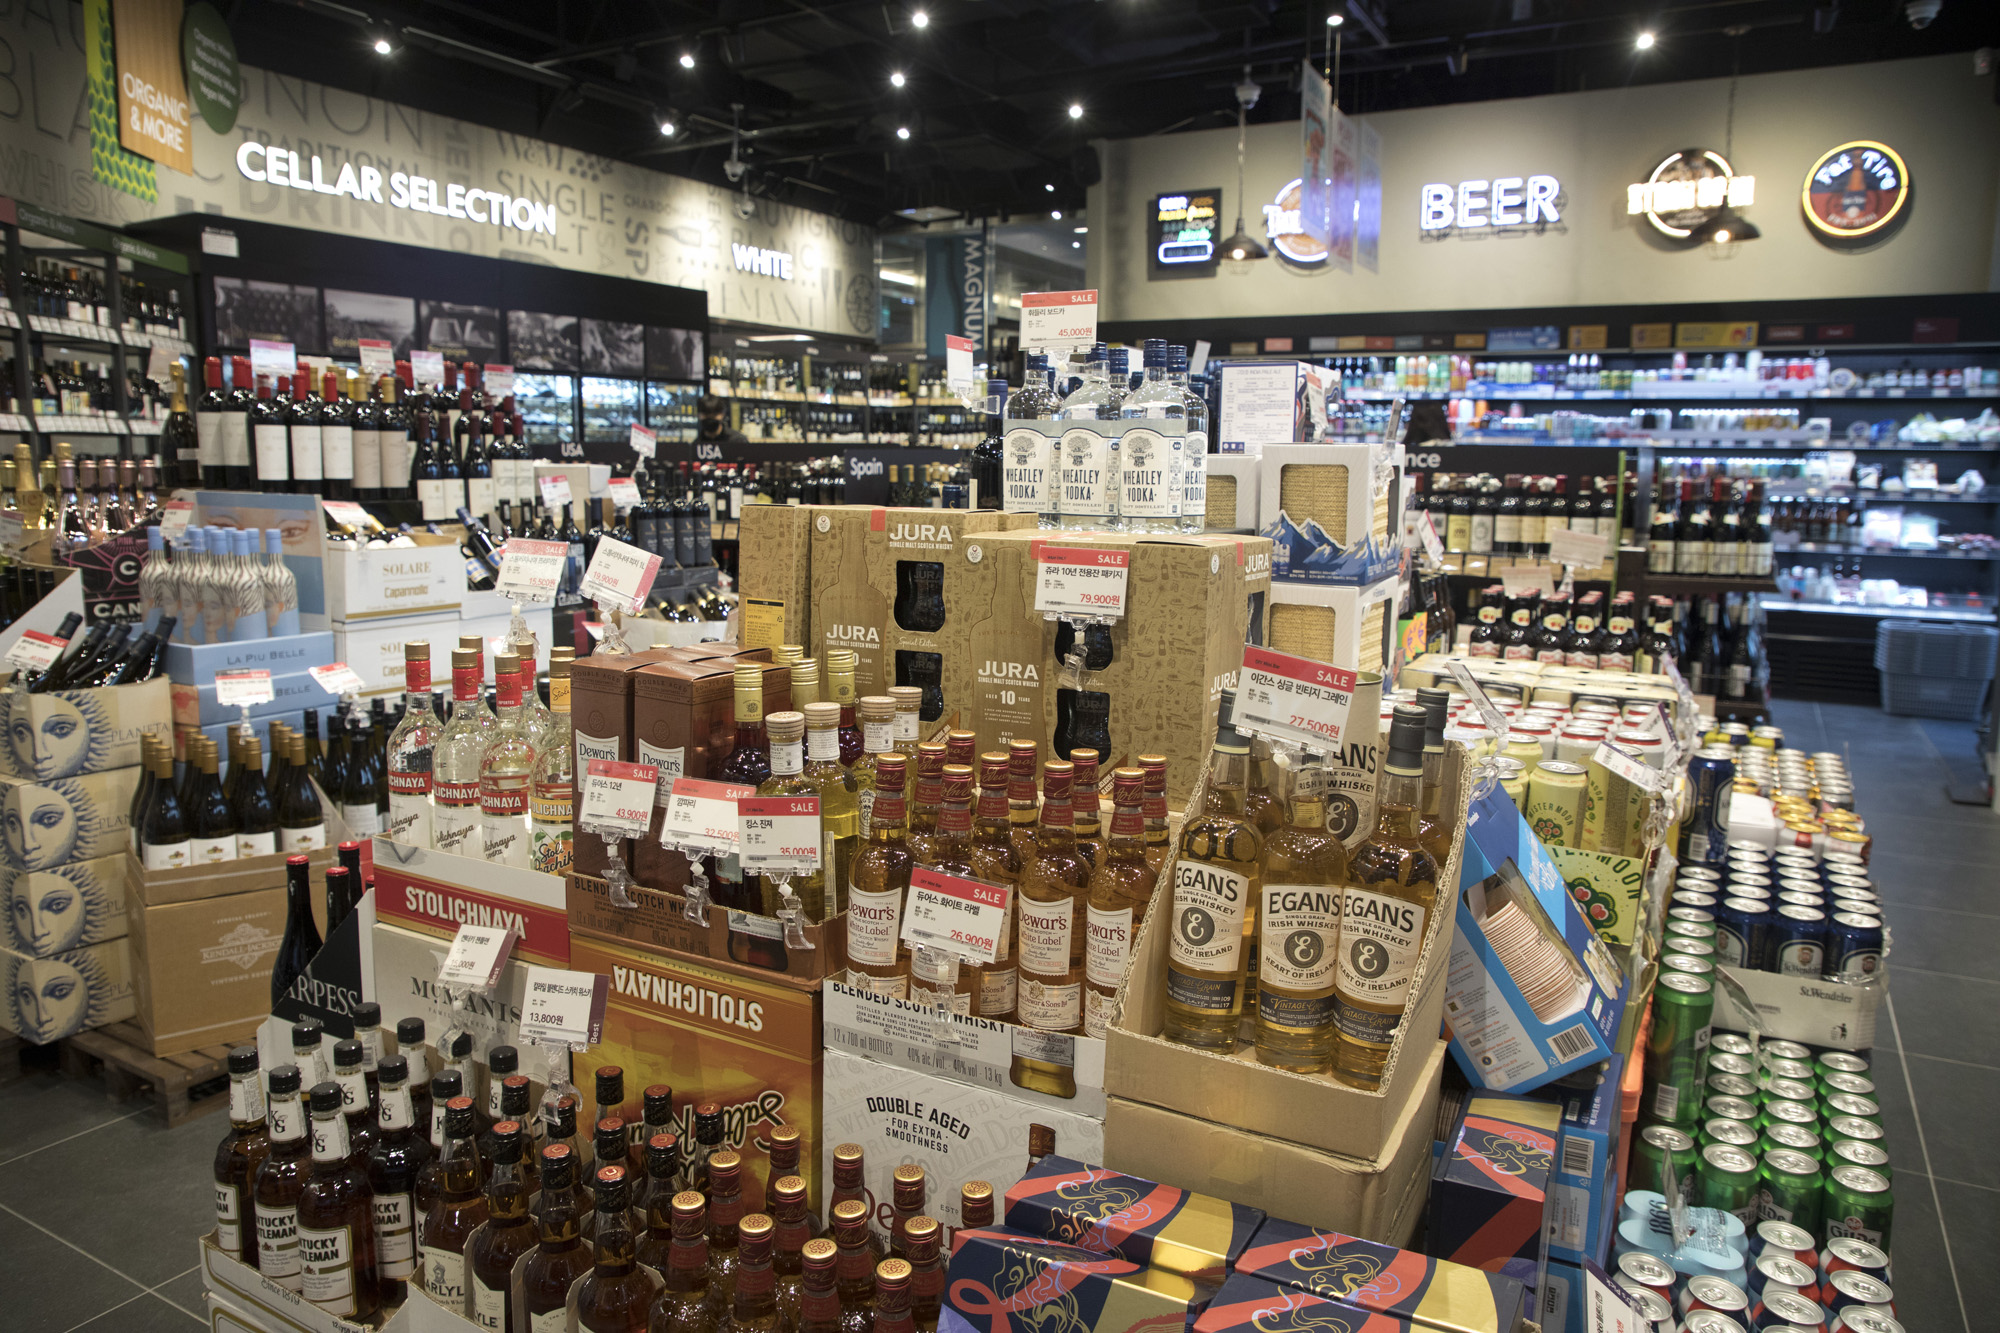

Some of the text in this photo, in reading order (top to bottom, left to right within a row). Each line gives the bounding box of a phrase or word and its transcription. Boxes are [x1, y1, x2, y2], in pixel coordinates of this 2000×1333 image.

[122, 71, 189, 127] ORGANIC
[130, 104, 185, 153] & MORE
[236, 141, 384, 204] CELLAR
[390, 171, 557, 236] SELECTION
[1420, 174, 1562, 231] BEER
[731, 242, 794, 281] WHITE
[1071, 294, 1093, 303] SALE
[1047, 307, 1065, 316] 보드카
[1058, 327, 1093, 337] 45,000원
[560, 442, 584, 458] USA
[697, 444, 723, 460] USA
[850, 456, 883, 480] Spain
[1006, 468, 1044, 483] WHEATLEY
[1062, 469, 1100, 484] WHEATLEY
[1123, 470, 1162, 485] WHEATLEY
[1009, 485, 1036, 499] VODKA
[1065, 486, 1092, 500] VODKA
[1127, 487, 1155, 502] VODKA
[889, 523, 953, 542] JURA
[545, 546, 565, 554] SALE
[1097, 554, 1123, 565] SALE
[1244, 553, 1270, 573] JURA
[382, 561, 432, 577] SOLARE
[1045, 566, 1123, 579] 쥬라 10년 전용잔 패키지
[592, 570, 620, 588] 19,900원
[1079, 593, 1121, 605] 79,900원
[826, 624, 880, 643] JURA
[865, 642, 880, 650] WHISKY
[227, 647, 306, 666] LA PIU BELLE
[978, 660, 1039, 681] JURA
[977, 676, 1040, 688] SINGLE MALT SCOTCH WHISKY
[1210, 670, 1238, 694] JURA
[1316, 670, 1350, 688] SALE
[275, 684, 312, 698] BELLE
[1250, 672, 1349, 707] 이간스 싱글 빈티지 그레인
[1000, 690, 1016, 706] 10
[1289, 714, 1341, 739] 27,500원
[578, 742, 616, 761] Dewar's
[642, 752, 681, 773] Dewar's
[632, 768, 654, 780] SALE
[591, 778, 623, 792] 듀어스 12년
[1326, 779, 1375, 793] WHISKEY
[725, 789, 750, 801] SALE
[615, 807, 649, 822] 43,900원
[790, 802, 814, 813] SALE
[1527, 801, 1575, 828] MISTER MOON
[745, 818, 760, 830] 킹스
[539, 842, 565, 865] Stoli
[779, 847, 817, 860] 35,000원
[626, 885, 665, 911] SCOTCH
[916, 890, 981, 917] 듀어스 화이트 라벨
[972, 888, 1002, 905] SALE
[1199, 892, 1218, 902] GRAIN
[1189, 896, 1237, 916] WHISKEY
[1343, 895, 1415, 934] EGAN'S
[864, 925, 889, 936] Label
[1087, 920, 1127, 942] ewar's
[1268, 919, 1340, 930] IRISH WHISKEY
[1352, 919, 1393, 934] SINGLE GRAIN
[950, 929, 994, 951] 26,900원
[1036, 936, 1063, 946] Label
[1362, 927, 1412, 948] WHISKEY
[1097, 945, 1121, 958] Label
[1184, 944, 1233, 958] OF IRELAND
[1265, 955, 1337, 980] HEART OF IRELAND
[488, 966, 501, 986] Best
[1354, 977, 1409, 991] OF IRELAND
[611, 962, 764, 1033] STOLICHNAYA
[1799, 984, 1853, 1005] St.Wendeler
[1045, 1000, 1061, 1008] Sons
[1270, 997, 1306, 1012] VINTAGE
[529, 1011, 564, 1027] 13,800원
[1368, 1013, 1395, 1028] GRAIN
[590, 1022, 601, 1045] Best
[833, 1027, 842, 1042] 12
[847, 1031, 859, 1047] 700
[859, 1034, 868, 1049] ml
[868, 1036, 894, 1057] BOTTLES
[907, 1047, 920, 1063] 40%
[952, 1058, 967, 1075] 40%
[967, 1061, 978, 1078] vol
[984, 1066, 994, 1082] 13
[993, 1069, 1004, 1088] kg
[865, 1095, 972, 1142] DOUBLE AGED
[891, 1117, 944, 1141] FOR EXTRA
[885, 1126, 950, 1154] SMOOTHNESS
